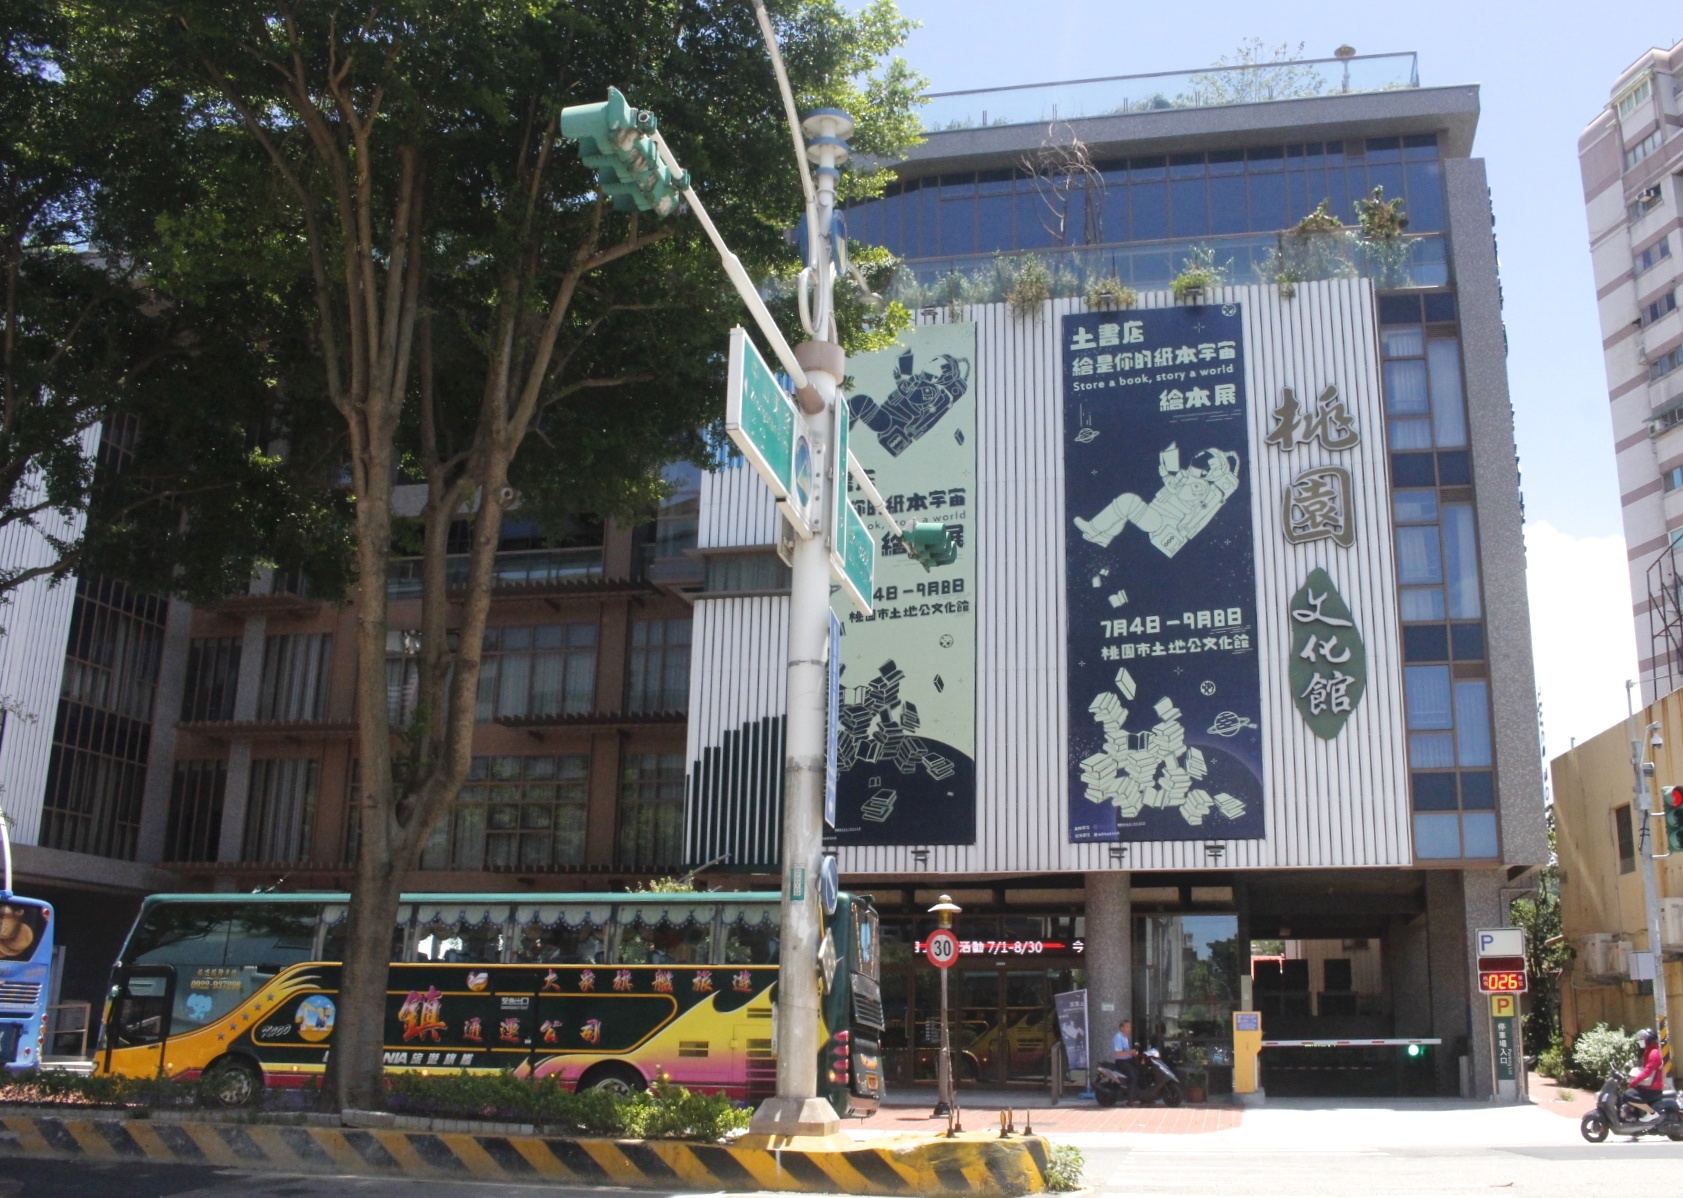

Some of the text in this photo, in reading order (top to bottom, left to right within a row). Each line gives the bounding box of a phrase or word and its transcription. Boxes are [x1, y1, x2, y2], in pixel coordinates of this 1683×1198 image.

[1070, 321, 1144, 350] 土書店
[1072, 341, 1236, 376] 繪是你的紙本宇宙
[1073, 380, 1105, 391] Store
[1119, 374, 1152, 387] book,
[1156, 370, 1186, 382] story
[1189, 370, 1196, 378] a
[1199, 364, 1234, 376] world
[1159, 383, 1236, 412] 繪本展
[933, 510, 966, 522] world
[1101, 633, 1250, 661] 桃園市土地公文化館
[1292, 587, 1355, 715] 文化館
[933, 940, 951, 957] 30
[988, 940, 1043, 955] 7/1-8/30
[1481, 935, 1494, 951] P
[1488, 974, 1519, 990] 026
[1497, 998, 1510, 1015] P
[1497, 1022, 1508, 1065] 停車場入口
